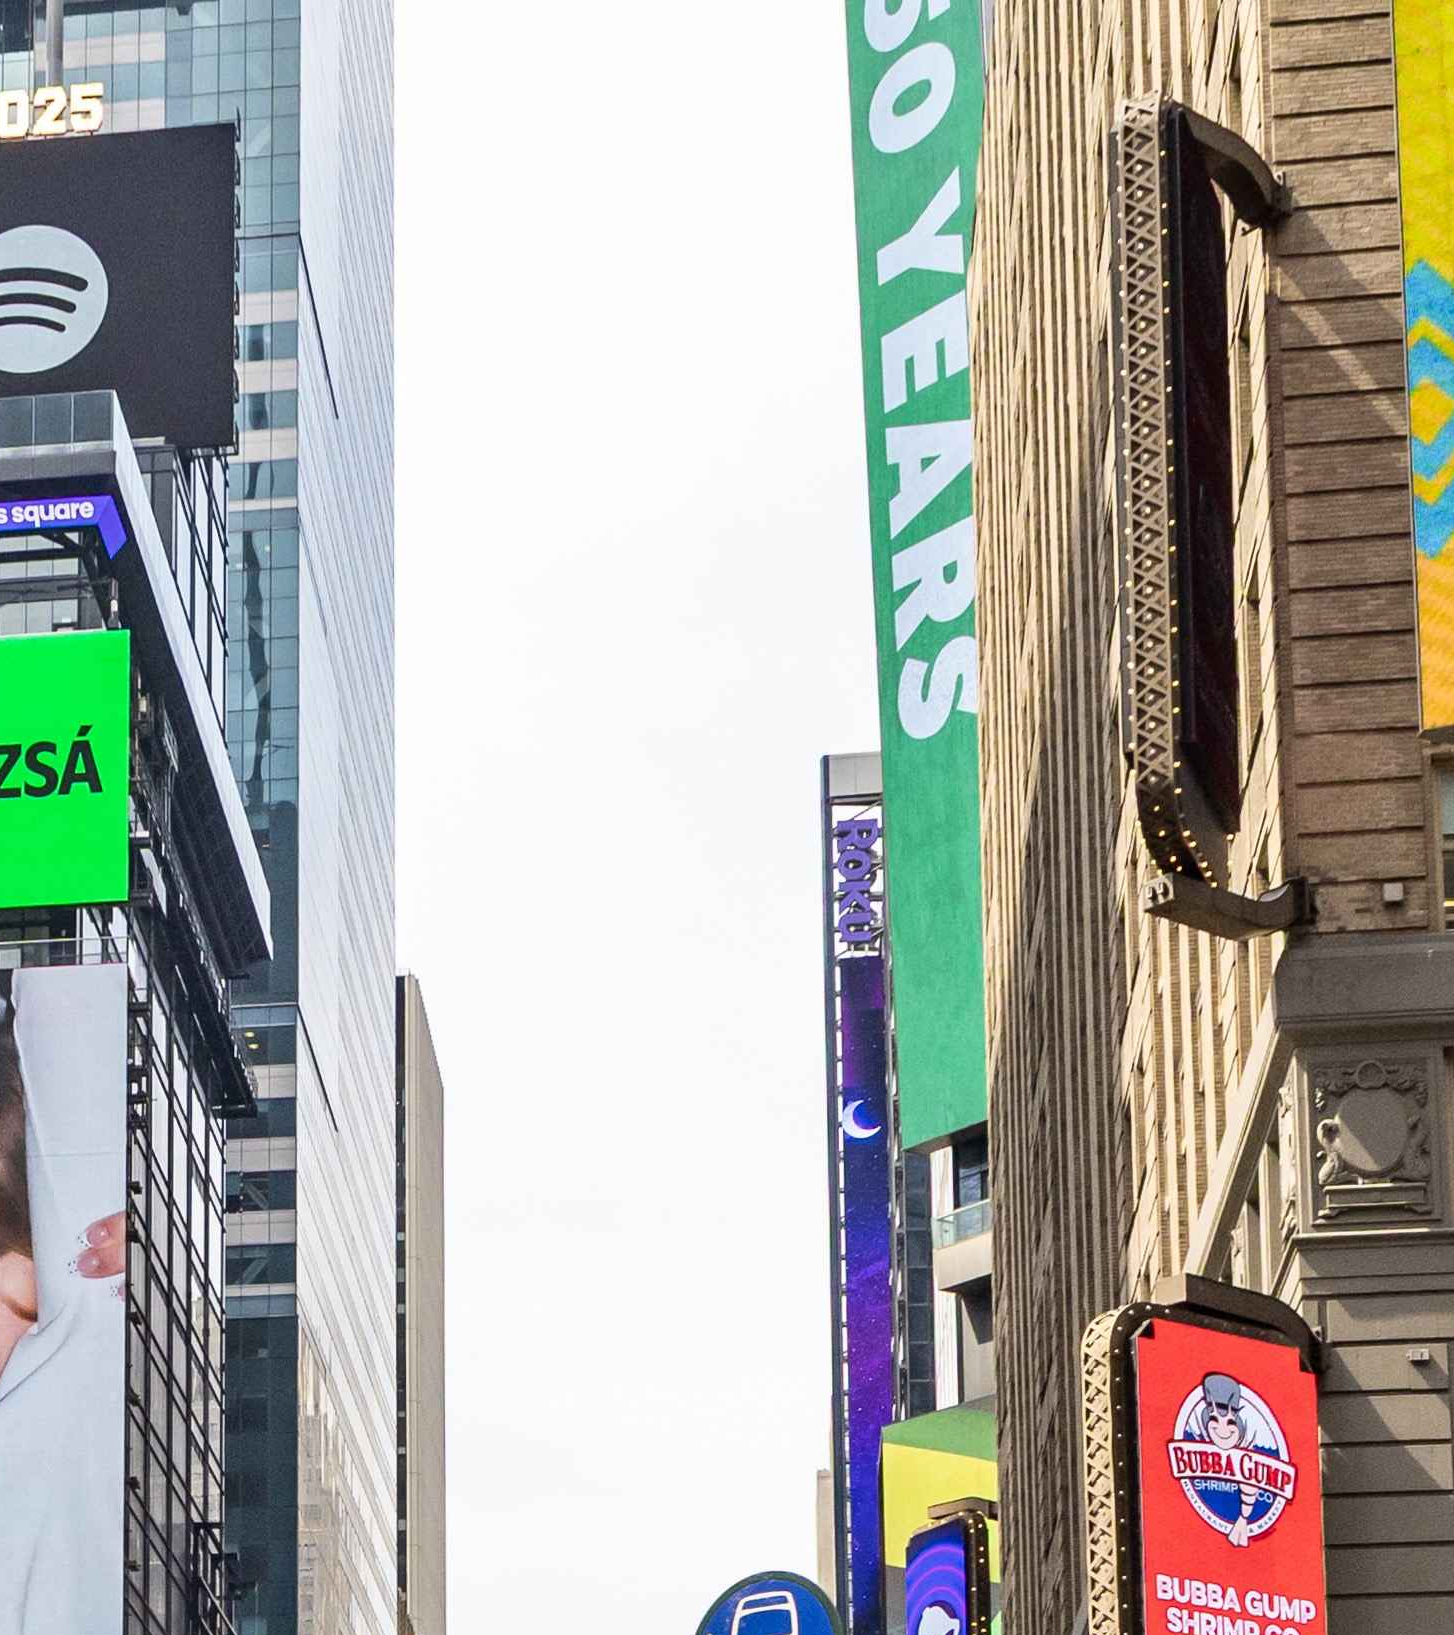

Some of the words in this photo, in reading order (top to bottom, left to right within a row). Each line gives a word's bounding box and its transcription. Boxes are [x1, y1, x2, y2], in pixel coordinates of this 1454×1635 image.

[875, 167, 980, 742] YEARS
[11, 498, 95, 527] square
[835, 817, 880, 947] ROKU
[1173, 1446, 1237, 1478] BUBBA
[1239, 1453, 1292, 1493] GUMP
[1193, 1479, 1239, 1493] SHRIMP
[1256, 1490, 1274, 1504] CO
[1155, 1573, 1242, 1612] BUBBA
[1244, 1588, 1317, 1626] GUMP
